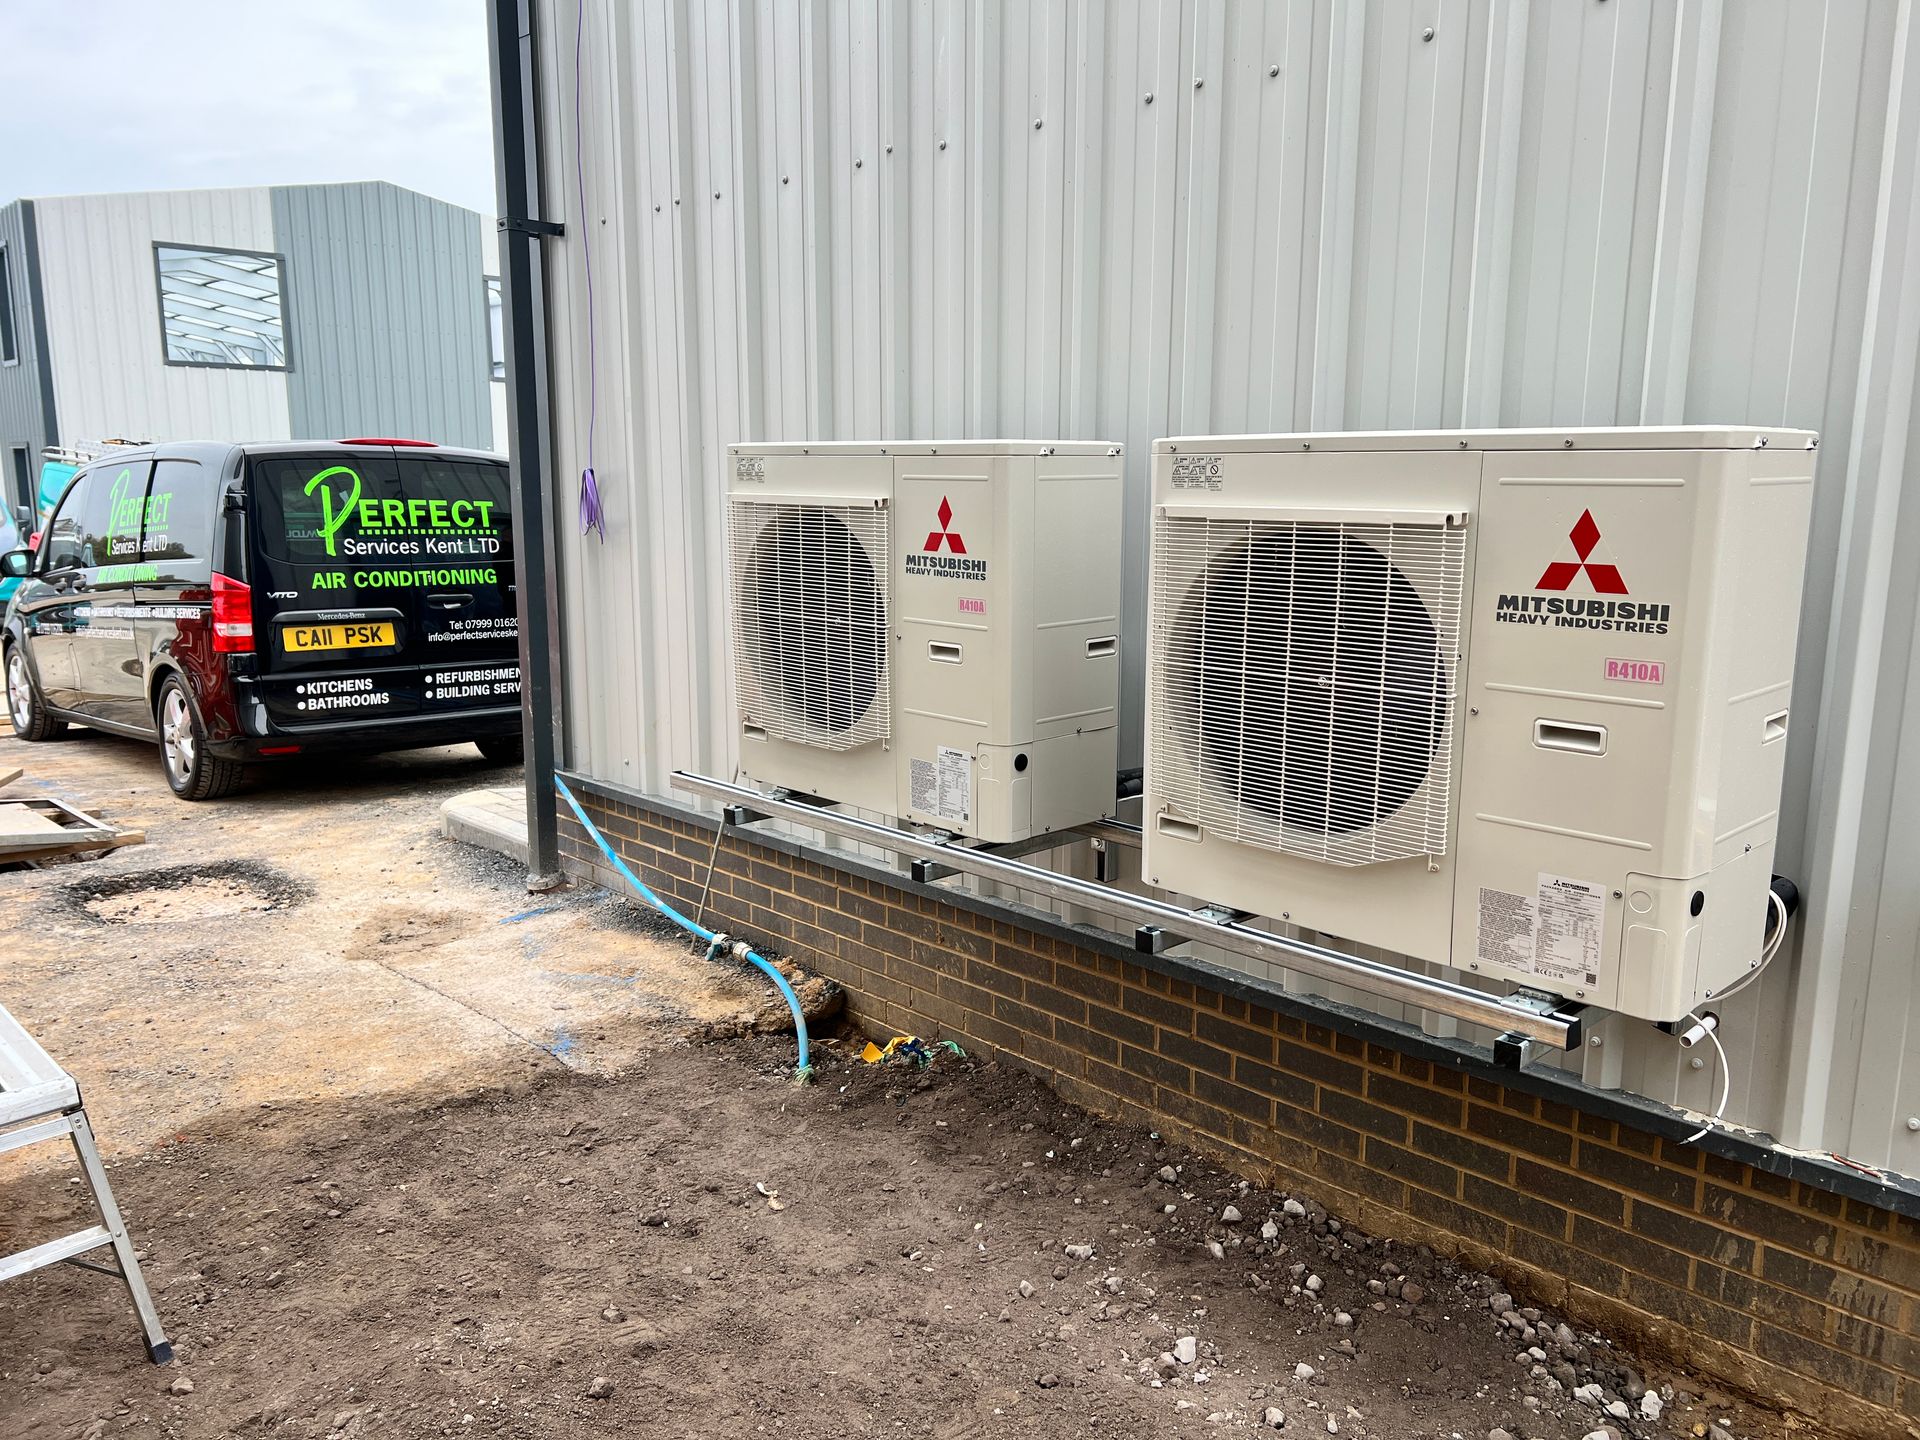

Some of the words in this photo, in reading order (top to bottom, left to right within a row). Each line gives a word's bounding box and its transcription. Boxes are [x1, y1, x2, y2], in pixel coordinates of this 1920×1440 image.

[304, 466, 494, 556] PERFECT
[153, 535, 168, 551] LTD
[344, 538, 419, 555] Services
[426, 537, 462, 554] Kent
[468, 537, 500, 554] LTD
[906, 554, 986, 573] MITSUBISHI
[311, 572, 347, 589] AIR
[354, 568, 497, 587] CONDITIONING
[905, 566, 932, 576] HEAVY
[933, 568, 986, 581] INDUSTRIES
[959, 599, 985, 613] R410A
[1497, 594, 1671, 622] MITSUBISHI
[317, 611, 366, 620] Mercedes-Benz
[465, 619, 492, 629] 07999
[1496, 611, 1550, 626] HEAVY
[1554, 616, 1668, 634] INDUSTRIES
[345, 626, 383, 643] PSK
[1607, 660, 1661, 682] R410A
[307, 678, 373, 695] KITCHENS
[436, 684, 490, 699] BUILDING
[308, 692, 389, 710] BATHROOMS
